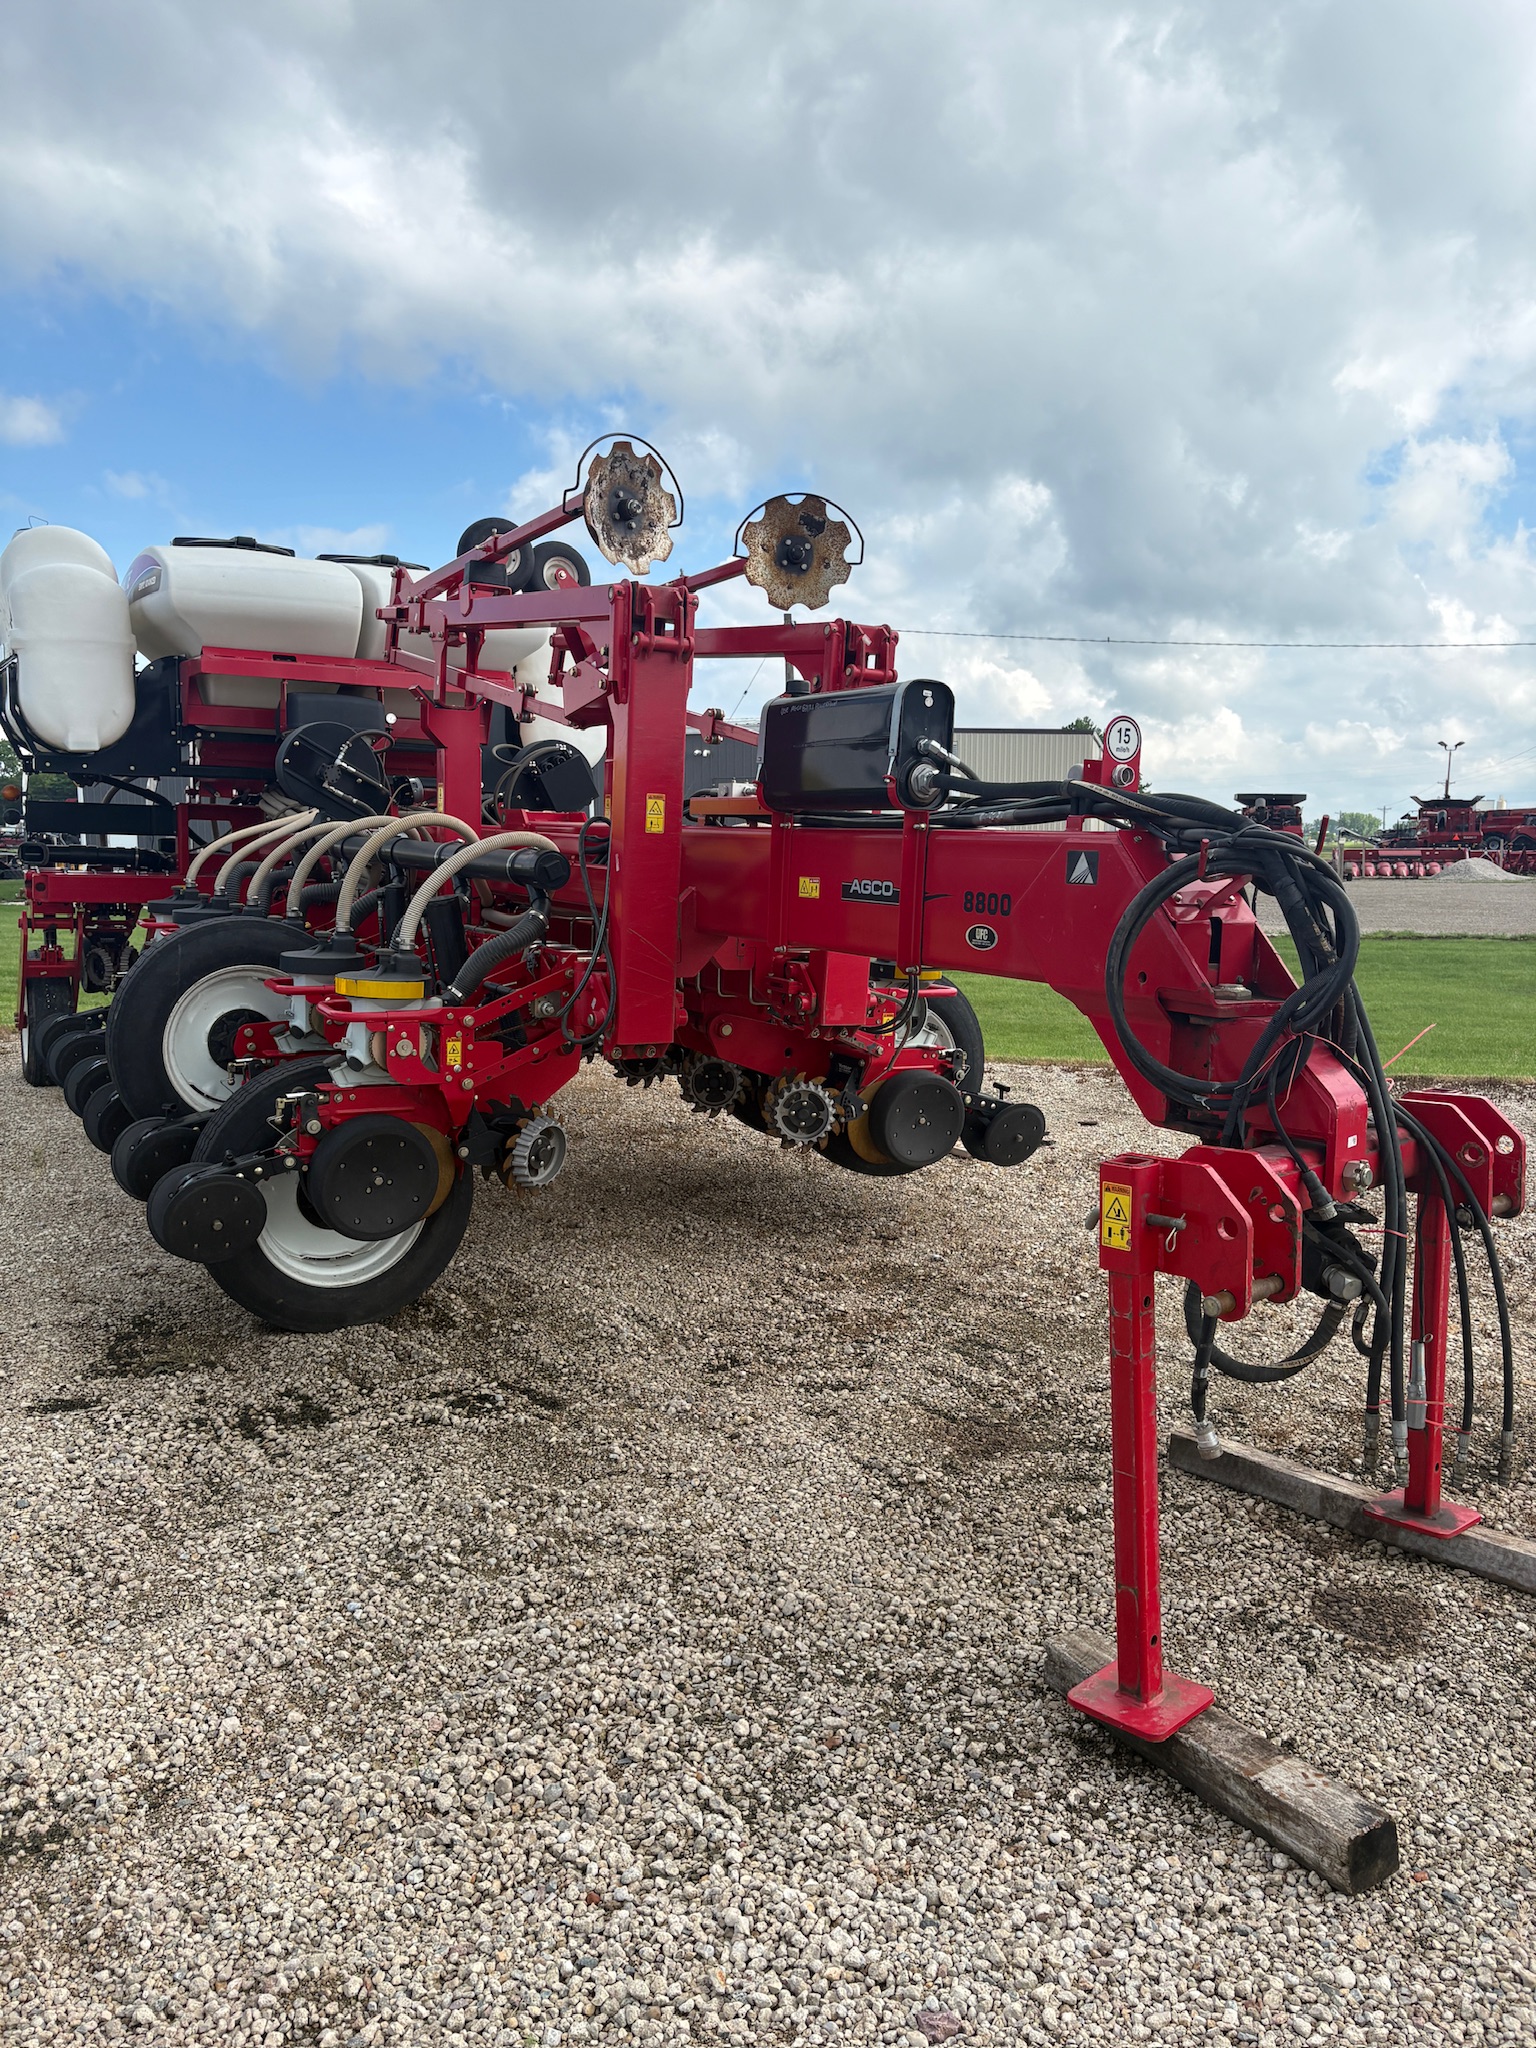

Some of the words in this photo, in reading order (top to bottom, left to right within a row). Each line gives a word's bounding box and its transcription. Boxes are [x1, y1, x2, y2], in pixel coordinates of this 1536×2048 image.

[1117, 727, 1131, 744] 15
[849, 879, 893, 896] AGCO
[963, 890, 1012, 917] 8800
